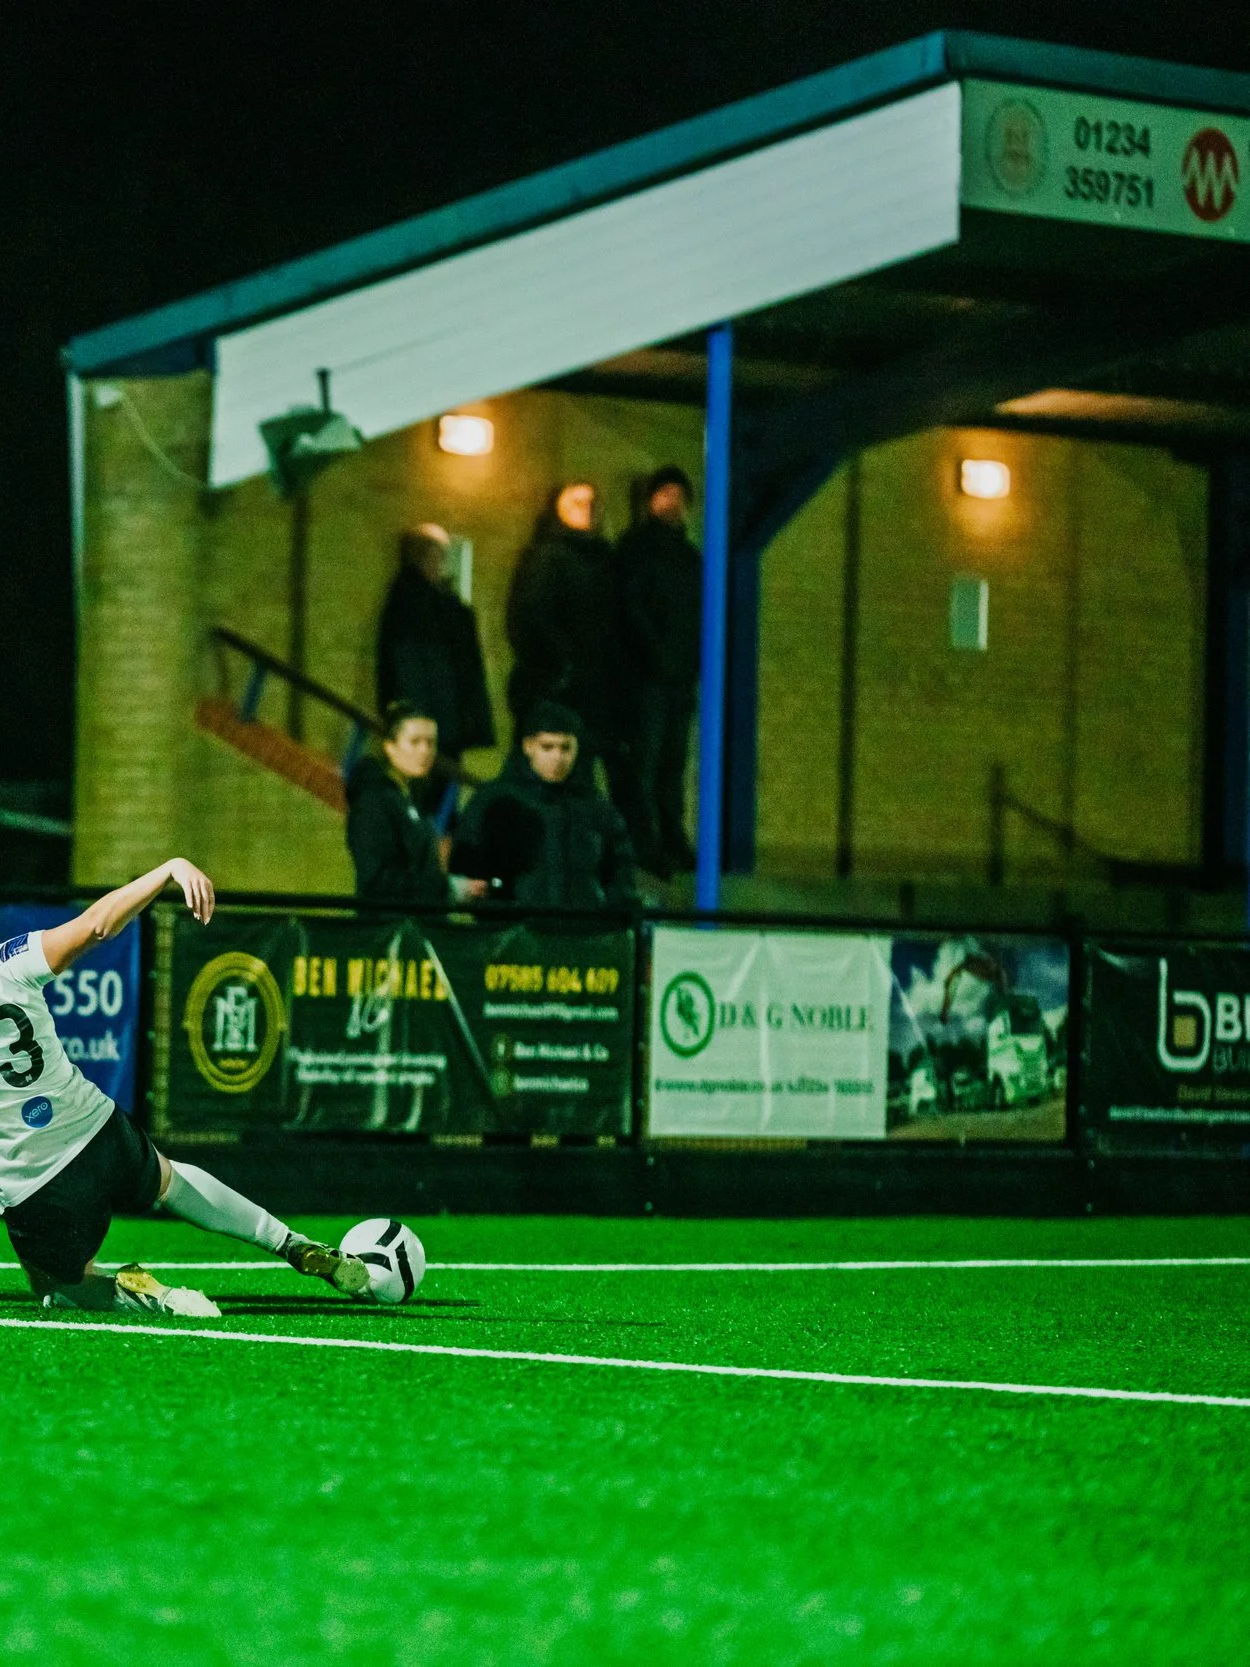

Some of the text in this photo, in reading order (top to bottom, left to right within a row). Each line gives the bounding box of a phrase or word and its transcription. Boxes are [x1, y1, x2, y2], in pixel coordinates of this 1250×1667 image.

[1073, 115, 1151, 159] 01234
[52, 968, 123, 1017] 550
[1215, 991, 1250, 1043] B
[24, 1102, 49, 1123] xero
